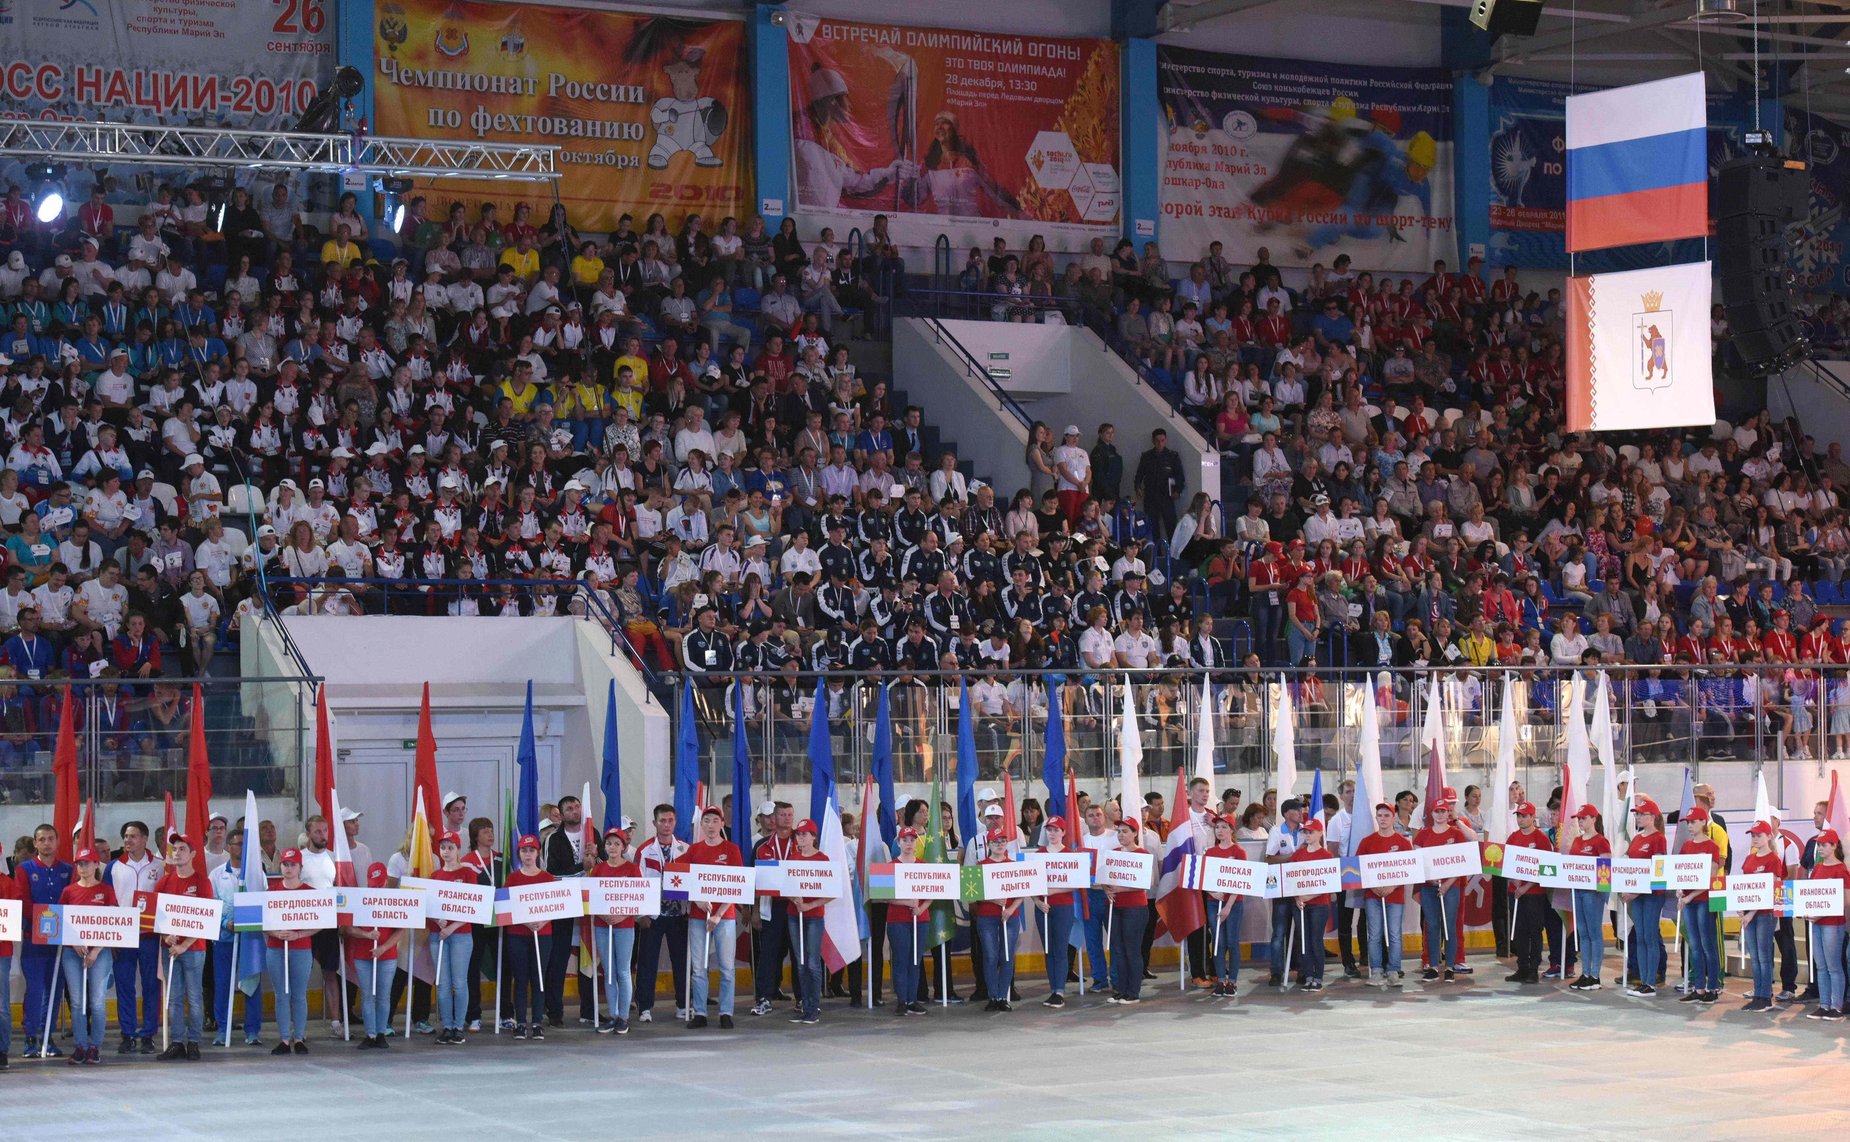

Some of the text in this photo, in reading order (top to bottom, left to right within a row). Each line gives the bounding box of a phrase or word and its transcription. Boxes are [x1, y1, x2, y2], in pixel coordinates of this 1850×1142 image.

[137, 16, 167, 24] спорта
[179, 18, 214, 27] туризма
[272, 0, 326, 33] 26
[127, 23, 178, 35] Республики
[182, 28, 210, 38] Марий
[266, 40, 330, 55] сентября
[822, 24, 1080, 60] ВСТРЕЧАЙ ОЛИМПИЙСКИЙ ОГОНЬ!
[946, 58, 1067, 78] ЭТО ТВОЯ ОЛИМПИАДА!
[379, 58, 645, 103] Чемпионат России
[945, 74, 1037, 91] 28 декабря, 13:30
[1207, 67, 1236, 77] спорта,
[1238, 69, 1270, 80] туризма
[1279, 72, 1328, 84] молодежной
[1330, 77, 1368, 86] политики
[1369, 79, 1413, 89] Российской
[76, 68, 317, 115] НАЦИИ-2010
[1253, 81, 1358, 97] Союз конькобежцев России
[946, 88, 1064, 105] Площадь перед Ледовым дворцом
[1211, 90, 1260, 103] физической
[1261, 94, 1301, 106] культуры,
[1303, 97, 1329, 108] спорта
[428, 106, 644, 141] по фехтованию
[1212, 144, 1237, 157] 2010
[1241, 149, 1248, 157] г.
[560, 150, 639, 171] октября
[1215, 161, 1250, 176] Марий
[1254, 164, 1267, 175] Эл
[1164, 176, 1225, 190] ошкар-Ола
[649, 183, 744, 201] 2010
[1298, 209, 1347, 225] России
[1550, 211, 1565, 219] 2011
[1045, 860, 1079, 870] РМСКИЙ
[1106, 858, 1143, 869] ОРЛОВСКАЯ
[1367, 858, 1417, 869] МУРМАНСКАЯ
[1433, 855, 1466, 866] МОСКВА
[1674, 862, 1703, 870] КИРОВСКАЯ
[787, 868, 833, 877] РЕСПУБЛИКА
[1219, 865, 1252, 876] ОМСКАЯ
[1286, 867, 1337, 878] НОВГОРОДСКАЯ
[1516, 867, 1539, 877] ОБЛАСТ
[1562, 862, 1595, 872] КУРГАНСКАЯ
[1612, 866, 1651, 875] КРАСНОДАРСКИЙ
[698, 872, 746, 883] РЕСПУБЛИКА
[904, 871, 951, 880] РЕСПУБЛИКА
[991, 868, 1038, 880] РЕСПУБЛИКА
[1047, 873, 1068, 883] КРАЙ
[1109, 871, 1137, 881] ОБЛАСТЬ
[1377, 870, 1409, 880] ОБЛАСТЬ
[1568, 874, 1591, 883] ОБЛАСТЬ
[1676, 875, 1699, 883] ОБЛАСТЬ
[599, 880, 651, 888] РЕСПУБЛИКА
[800, 881, 822, 890] КРЫМ
[1001, 882, 1030, 892] АДЫГЕЯ
[1216, 878, 1252, 890] ОБЛАСТЬ
[1296, 879, 1327, 888] ОБЛАСТЬ
[1625, 878, 1637, 887] КРАЙ
[1732, 882, 1766, 891] КАЛУЖСКАЯ
[701, 885, 742, 897] МОРДОВИЯ
[911, 884, 944, 893] КАРЕЛИЯ
[1800, 888, 1836, 896] ИВАНОВСКАЯ
[438, 889, 483, 903] РЯЗАНСКАЯ
[520, 889, 572, 902] РЕСПУБЛИКА
[604, 893, 644, 902] СЕВЕРНАЯ
[1737, 895, 1761, 903] ОБЛАСТЬ
[268, 898, 333, 909] СВЕРДЛОВСКАЯ
[362, 897, 419, 907] САРАТОВСКАЯ
[1805, 901, 1831, 909] ОБЛАСТЬ
[165, 903, 214, 917] СМОЛЕНСКАЯ
[441, 903, 476, 915] ОБЛАСТЬ
[529, 903, 565, 914] ХАКАСИЯ
[610, 907, 639, 915] ОСЕТИЯ
[70, 915, 133, 926] ТАМБОВСКАЯ
[282, 912, 319, 921] ОБЛАСТЬ
[372, 910, 408, 920] ОБЛАСТЬ
[171, 918, 204, 930] ОБЛАСТЬ
[79, 929, 122, 940] ОБЛАСТЬ
